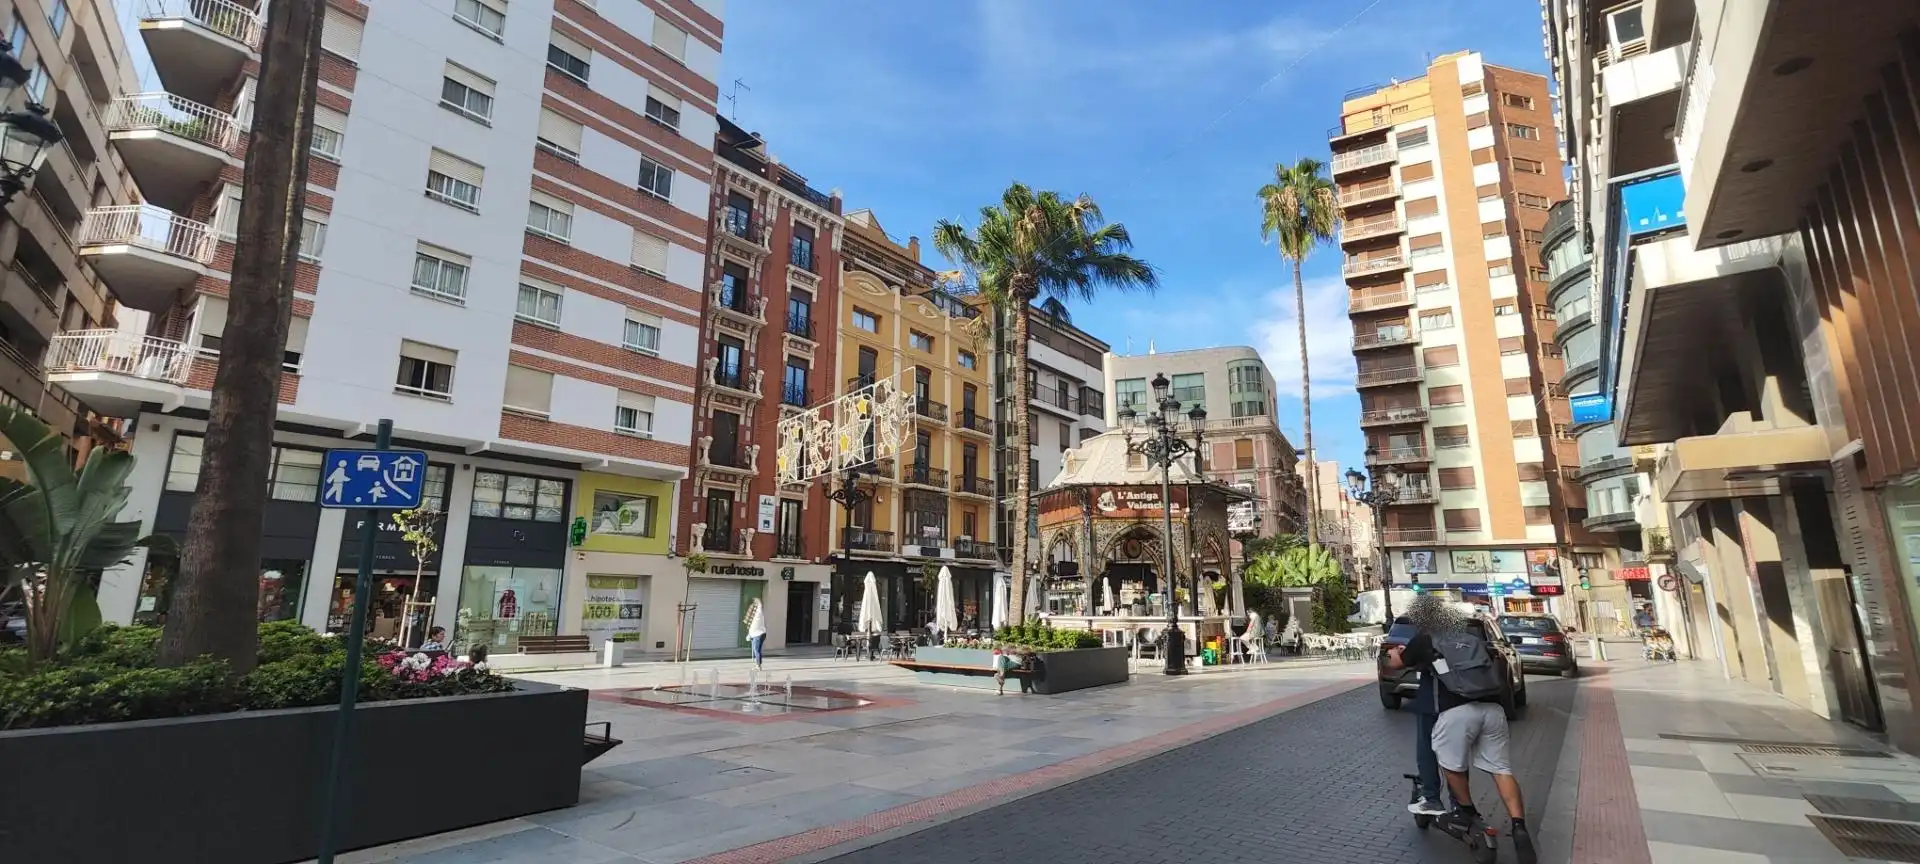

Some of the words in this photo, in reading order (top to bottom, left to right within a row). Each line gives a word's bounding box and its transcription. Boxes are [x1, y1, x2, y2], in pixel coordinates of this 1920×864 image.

[1117, 491, 1158, 501] L'Antiga
[1127, 501, 1180, 509] Valencina
[711, 563, 765, 576] ruralnostra
